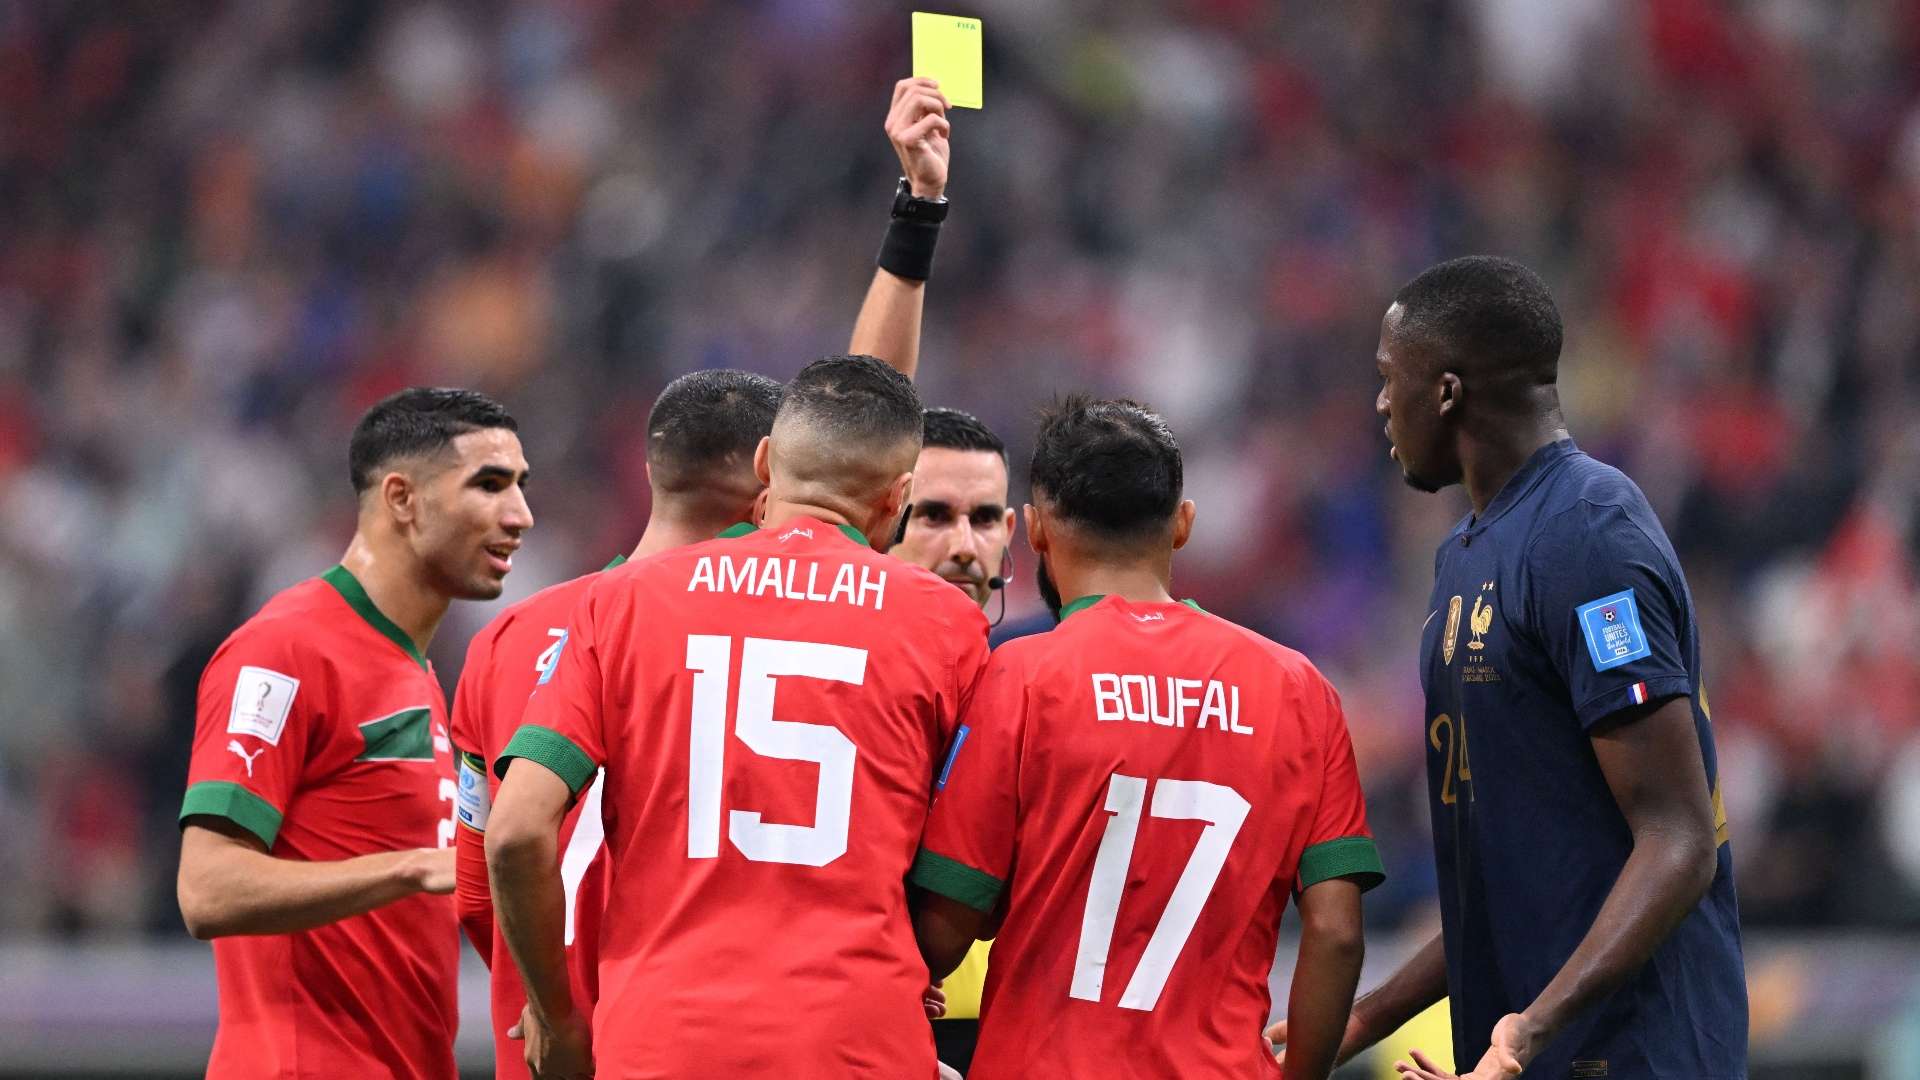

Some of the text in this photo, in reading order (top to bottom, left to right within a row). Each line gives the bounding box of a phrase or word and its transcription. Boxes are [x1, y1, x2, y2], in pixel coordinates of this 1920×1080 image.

[687, 555, 887, 611] AMALLAH
[1604, 629, 1628, 642] UNITES
[1092, 673, 1254, 735] BOUFAL
[686, 634, 868, 867] 15
[1070, 773, 1251, 1011] 17
